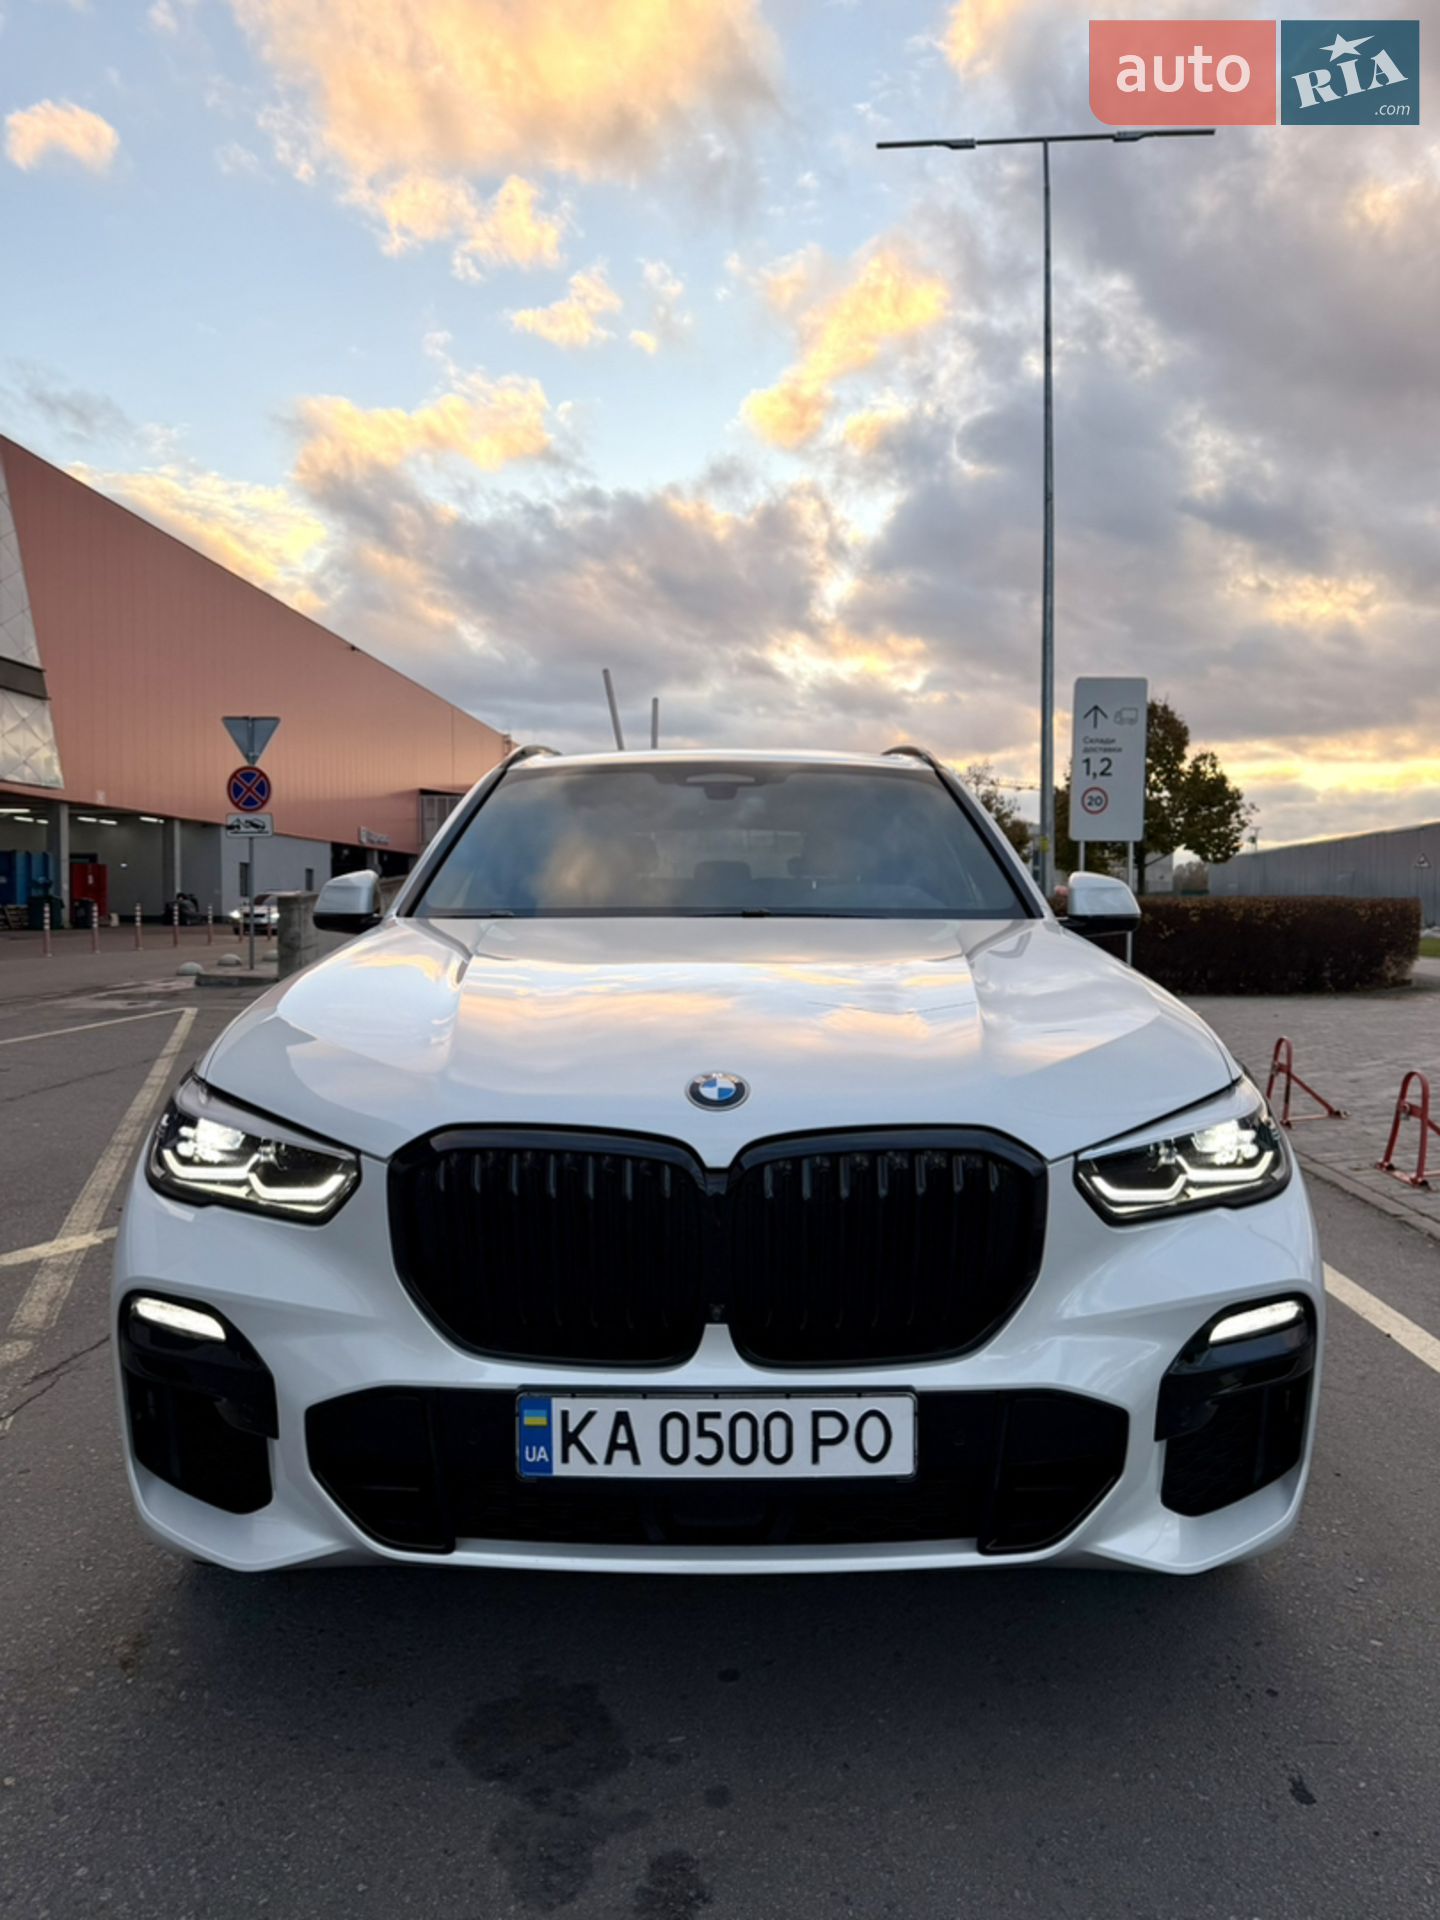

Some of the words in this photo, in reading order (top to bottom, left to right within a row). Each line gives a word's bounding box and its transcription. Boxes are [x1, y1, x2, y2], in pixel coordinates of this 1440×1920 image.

[1082, 735, 1116, 745] Склади
[1082, 757, 1113, 780] 1,2
[1087, 795, 1103, 807] 20
[560, 1410, 641, 1465] KA
[659, 1410, 794, 1466] 0500
[811, 1409, 893, 1465] PO
[524, 1446, 549, 1462] UA
